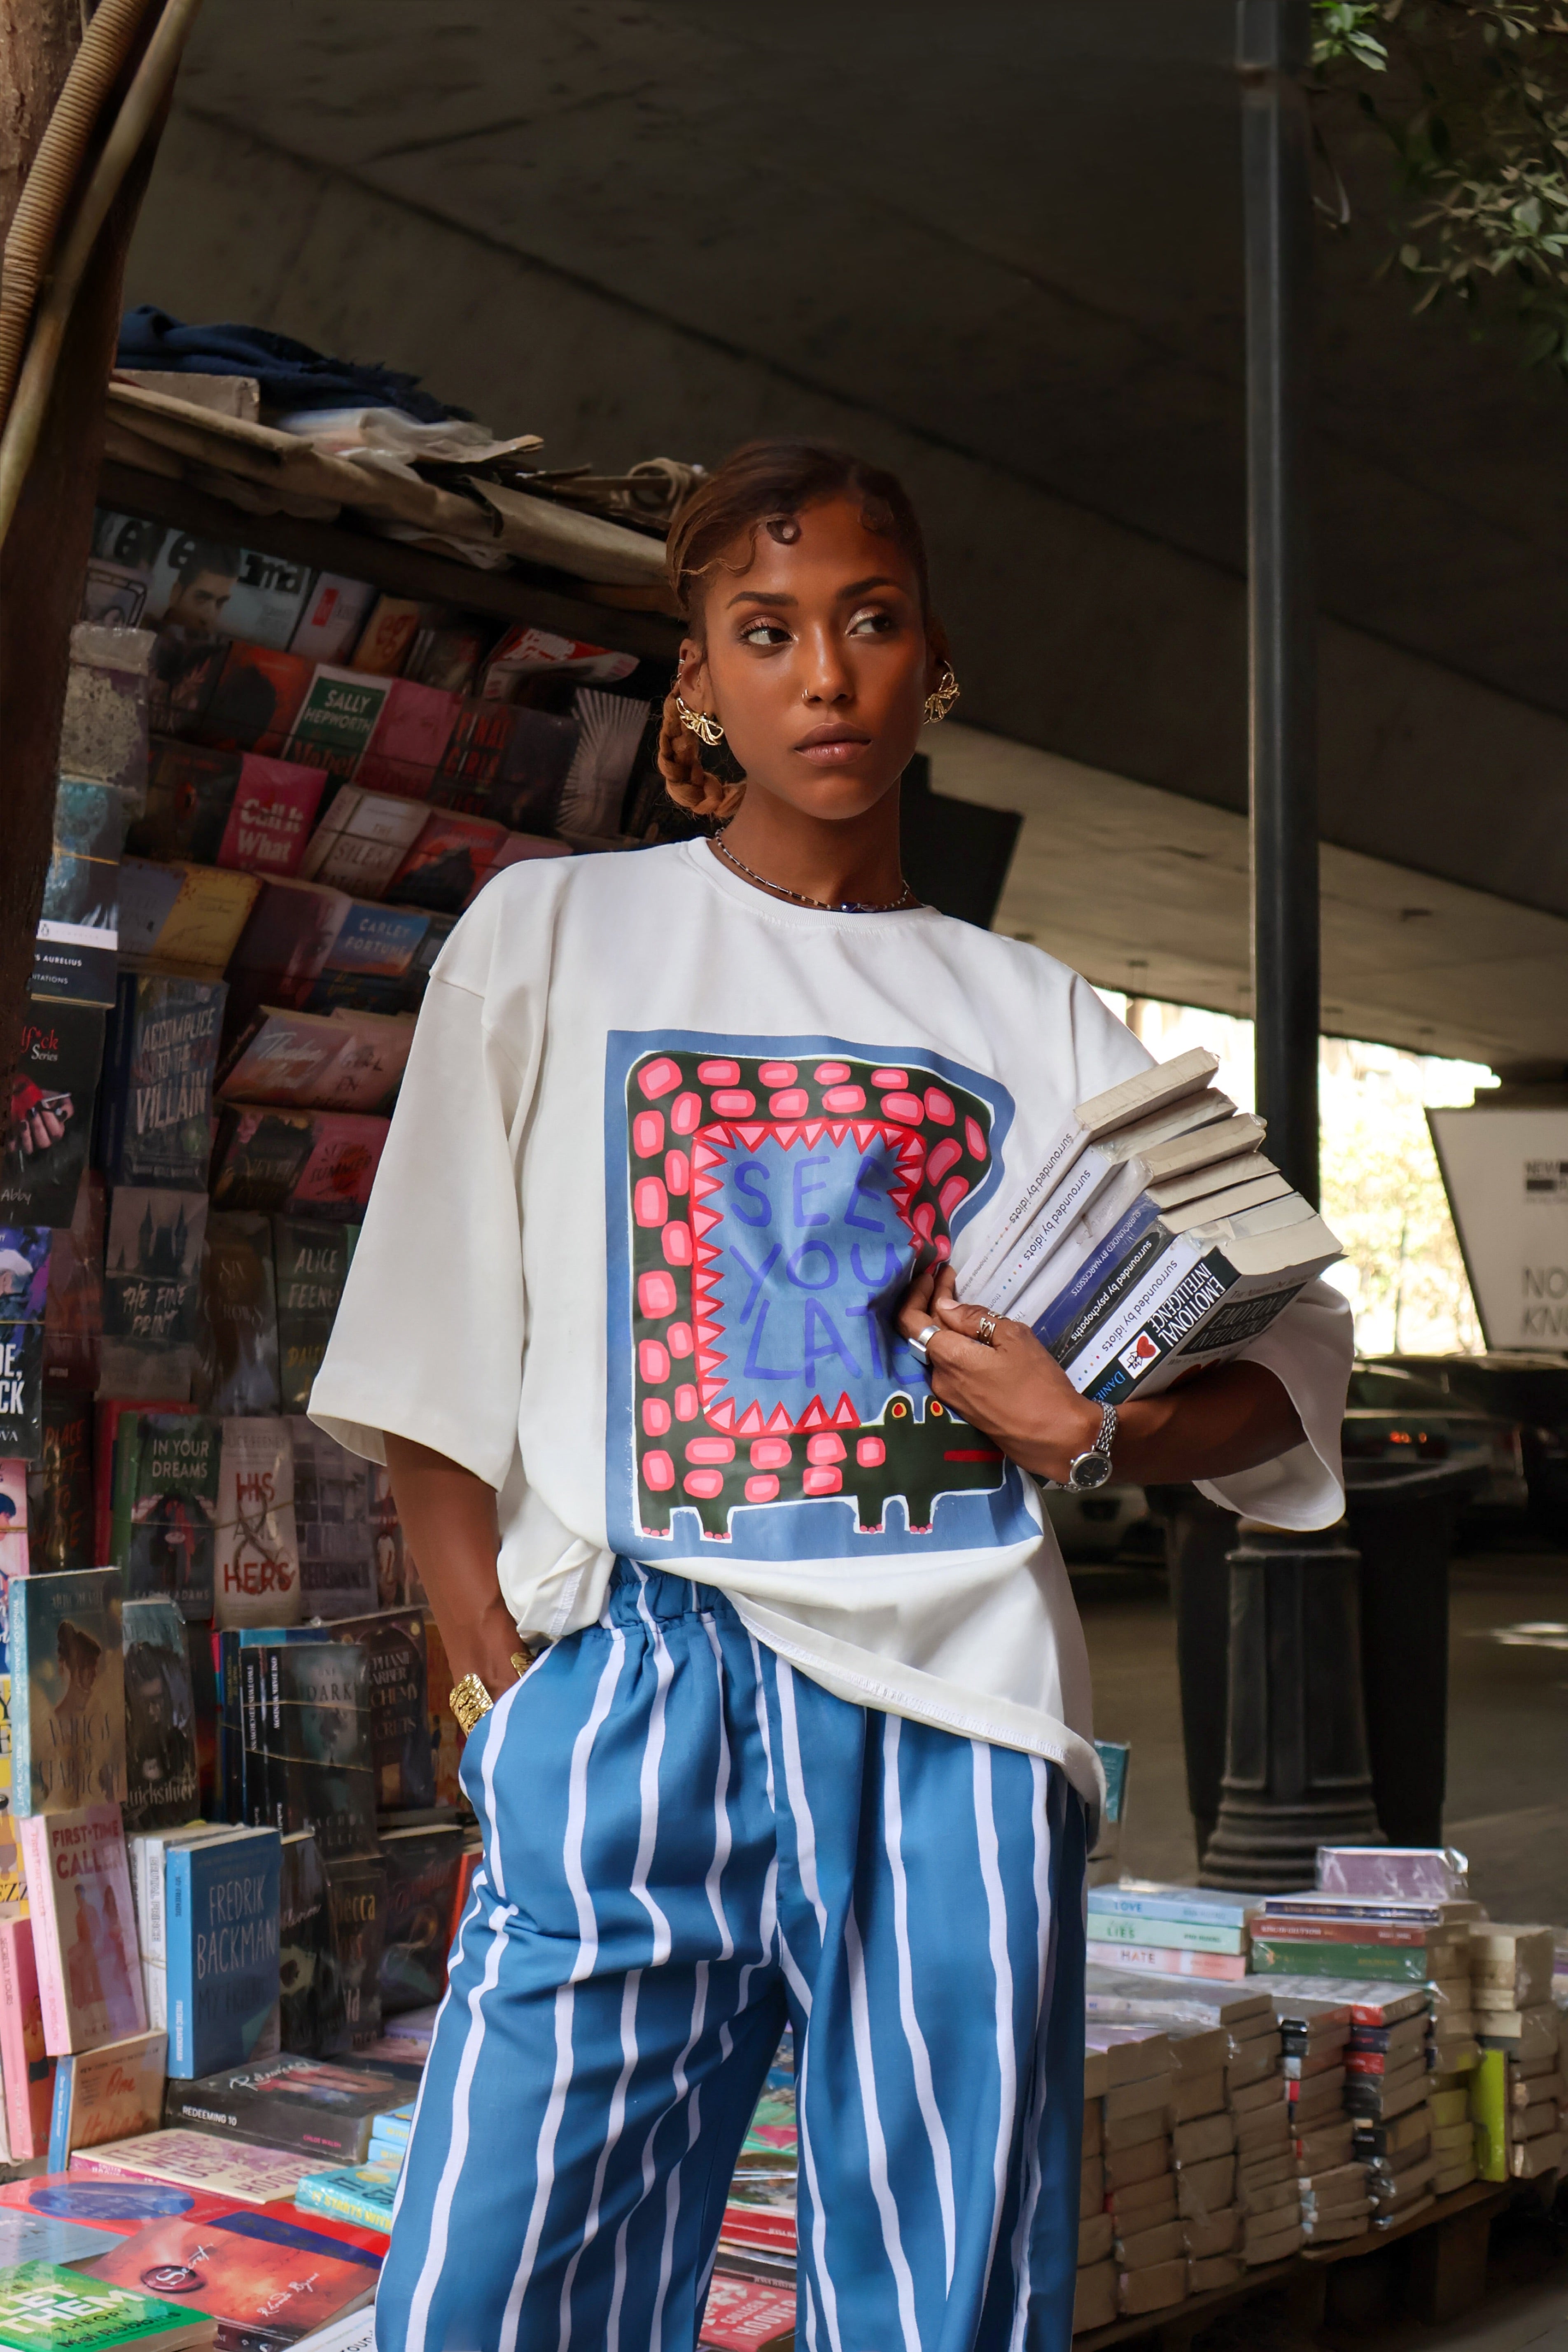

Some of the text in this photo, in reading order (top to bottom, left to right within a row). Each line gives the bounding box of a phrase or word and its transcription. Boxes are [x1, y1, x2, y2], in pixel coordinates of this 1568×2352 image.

[324, 689, 371, 714] SALLY
[304, 707, 373, 733] HEPWORTH
[238, 828, 292, 863] What
[359, 917, 411, 937] CARLEY
[42, 954, 83, 968] AURELIUS
[31, 1043, 59, 1062] Series
[136, 1068, 208, 1135] VILLAIN
[1009, 1132, 1072, 1223] surrounded by idiots
[0, 1188, 32, 1205] Abby
[730, 1155, 889, 1233] SEE
[1024, 1169, 1091, 1261] surrounded by idiots
[1107, 1211, 1142, 1253] SURROUNDED
[294, 1248, 338, 1274] ALICE
[1099, 1250, 1109, 1261] BY
[729, 1239, 903, 1325] YOU
[1071, 1257, 1102, 1296] NARCISSISTS
[1071, 1240, 1153, 1342] surrounded by psychopaths
[123, 1282, 150, 1314] THE
[154, 1284, 187, 1313] FINE
[1101, 1260, 1178, 1353] surrounded by idiots
[1147, 1262, 1212, 1334] INTELLIGENCE
[1157, 1275, 1227, 1348] EMOTIONAL
[153, 1439, 168, 1456] IN
[172, 1439, 210, 1458] YOUR
[151, 1460, 208, 1479] DREAMS
[235, 1472, 275, 1502] HIS
[224, 1562, 296, 1595] HERS
[14, 1631, 20, 1643] OF
[308, 1682, 352, 1702] DARK
[149, 1856, 161, 1943] BRUTAL PRINCE
[209, 1874, 266, 1927] FREDRIK
[1114, 1902, 1143, 1913] LOVE
[196, 1917, 278, 1980] BACKMAN
[1107, 1926, 1136, 1939] LIES
[0, 1938, 14, 2005] SECRETLY YOURS
[1120, 1950, 1156, 1964] HATE
[182, 2105, 227, 2125] REDEEMING
[311, 2191, 323, 2203] IT
[324, 2194, 362, 2219] STARTS
[364, 2208, 392, 2229] WITH
[0, 2289, 147, 2335] THEM
[54, 2307, 133, 2333] THEORY
[98, 2310, 182, 2339] Robbins
